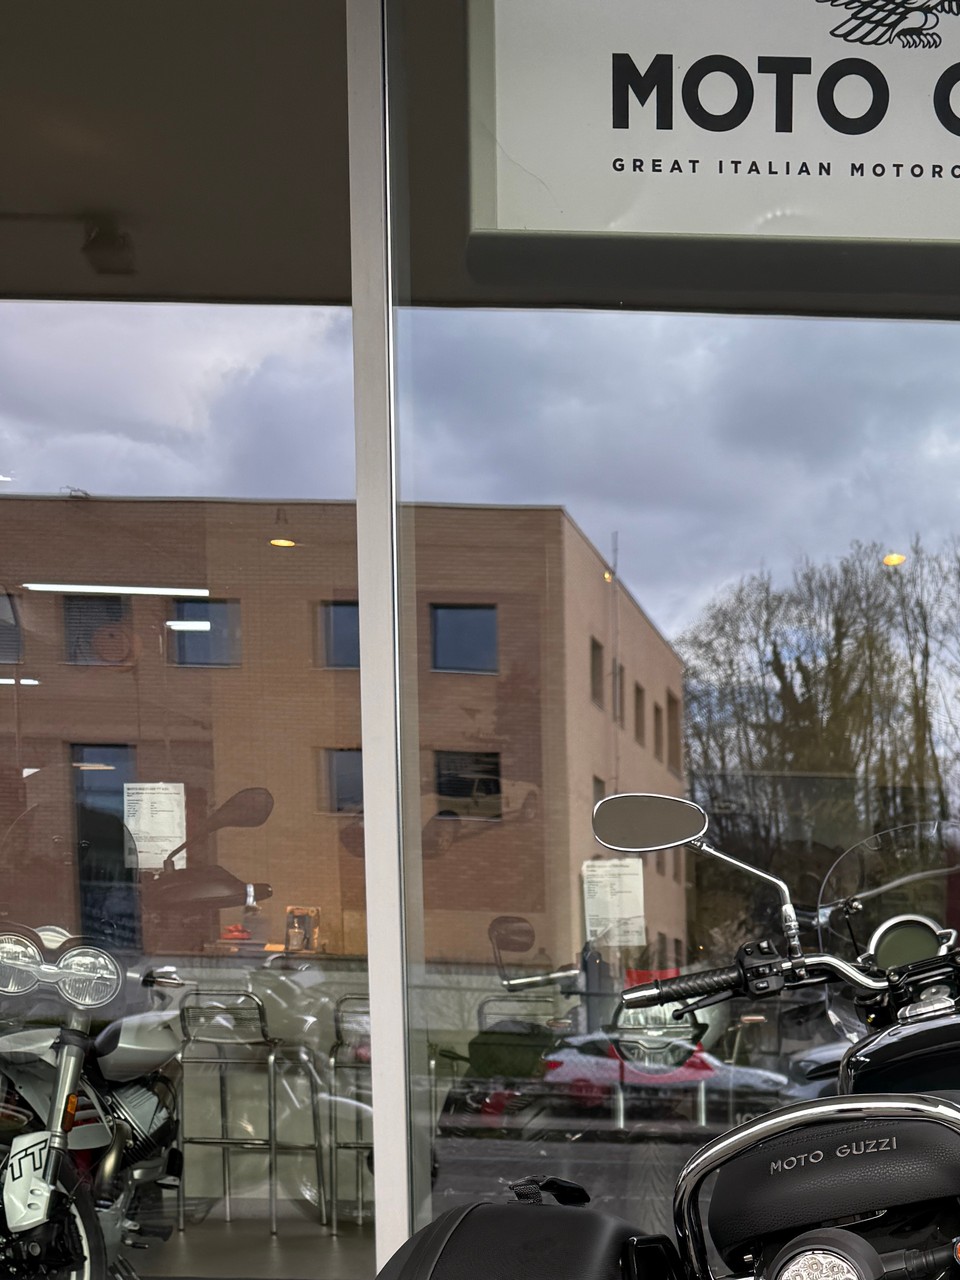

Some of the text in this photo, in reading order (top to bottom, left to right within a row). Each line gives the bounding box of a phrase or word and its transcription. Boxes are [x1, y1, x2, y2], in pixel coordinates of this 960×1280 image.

[612, 53, 890, 135] MOTO
[612, 157, 700, 174] GREAT
[718, 160, 832, 176] ITALIAN
[9, 1138, 49, 1182] TT
[769, 1136, 897, 1175] MOTO GUZZI
